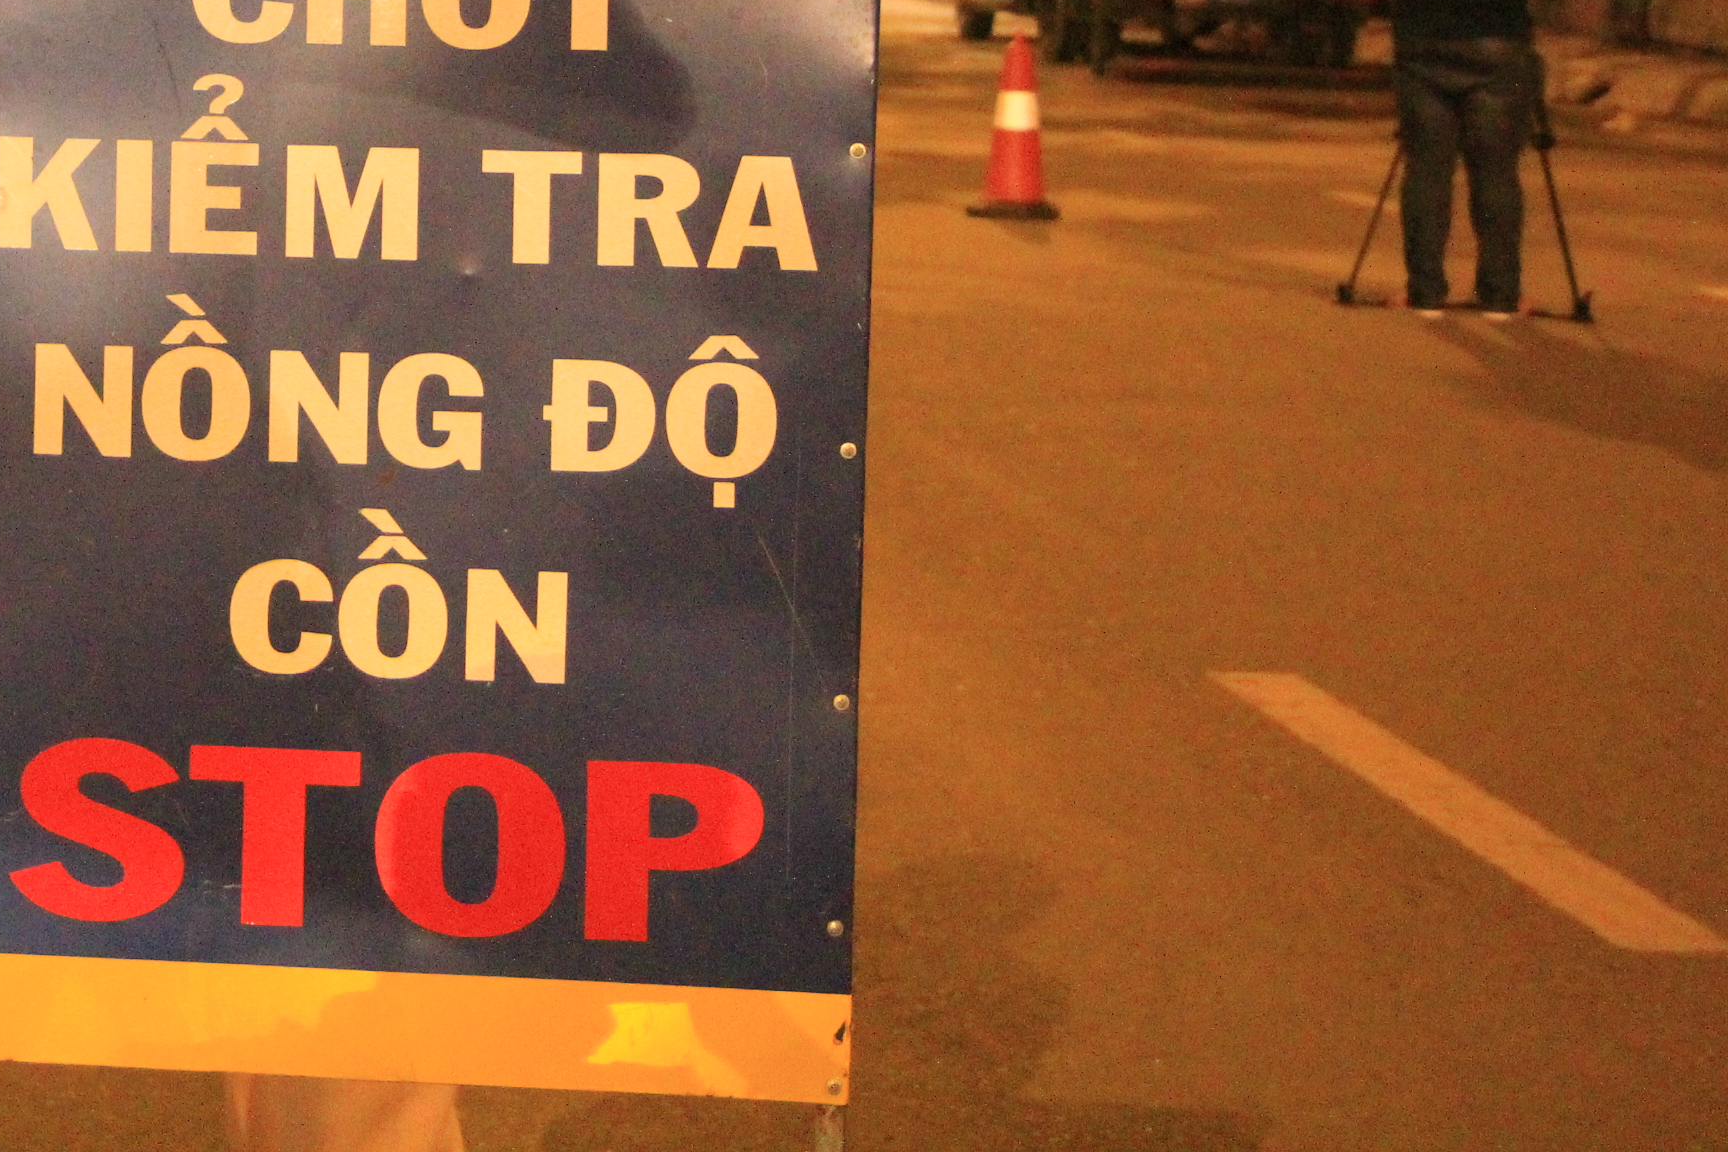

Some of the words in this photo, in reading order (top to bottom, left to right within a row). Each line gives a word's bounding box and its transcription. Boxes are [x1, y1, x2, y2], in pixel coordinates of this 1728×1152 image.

[481, 149, 819, 272] TRA
[32, 293, 485, 472] NỒNG
[542, 334, 778, 510] ĐỘ
[229, 507, 569, 685] CỒN
[8, 736, 765, 943] STOP
